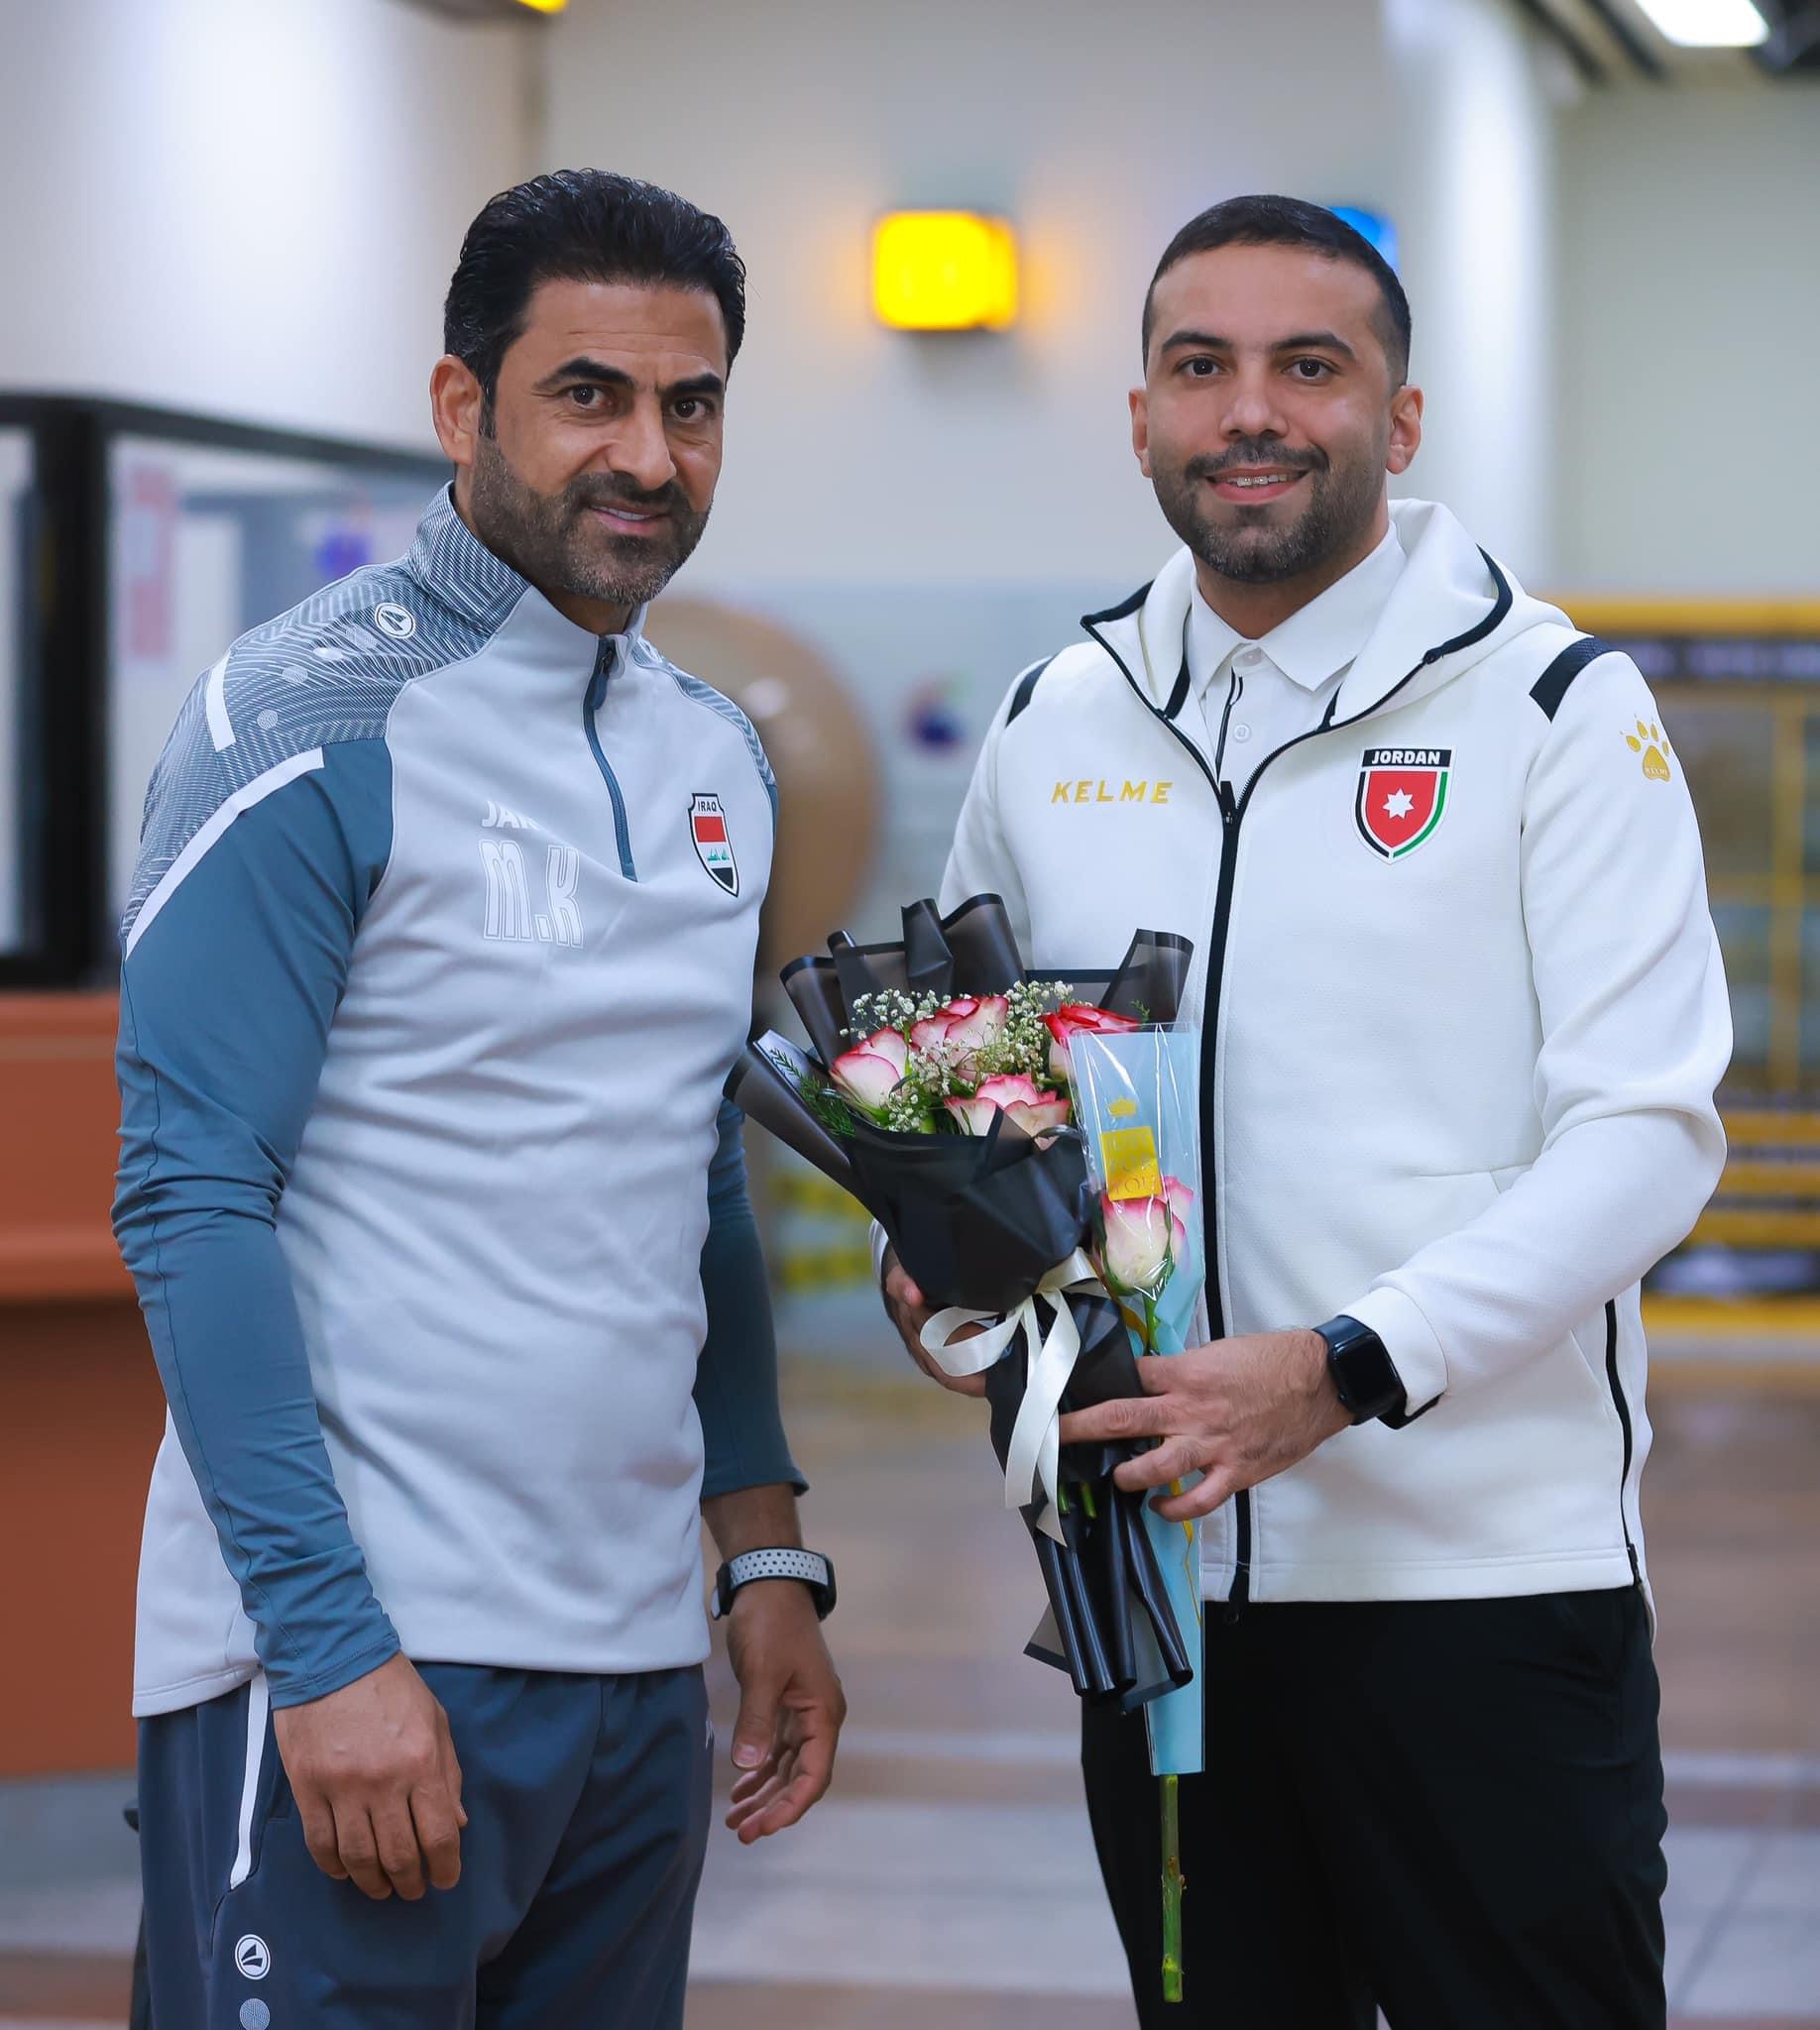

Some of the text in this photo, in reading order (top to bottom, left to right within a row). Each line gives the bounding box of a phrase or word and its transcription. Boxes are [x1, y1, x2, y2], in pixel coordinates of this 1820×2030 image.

[1371, 750, 1441, 765] JORDAN
[1051, 779, 1174, 804] KELME
[697, 800, 718, 812] IRAQ
[479, 840, 584, 949] M.K
